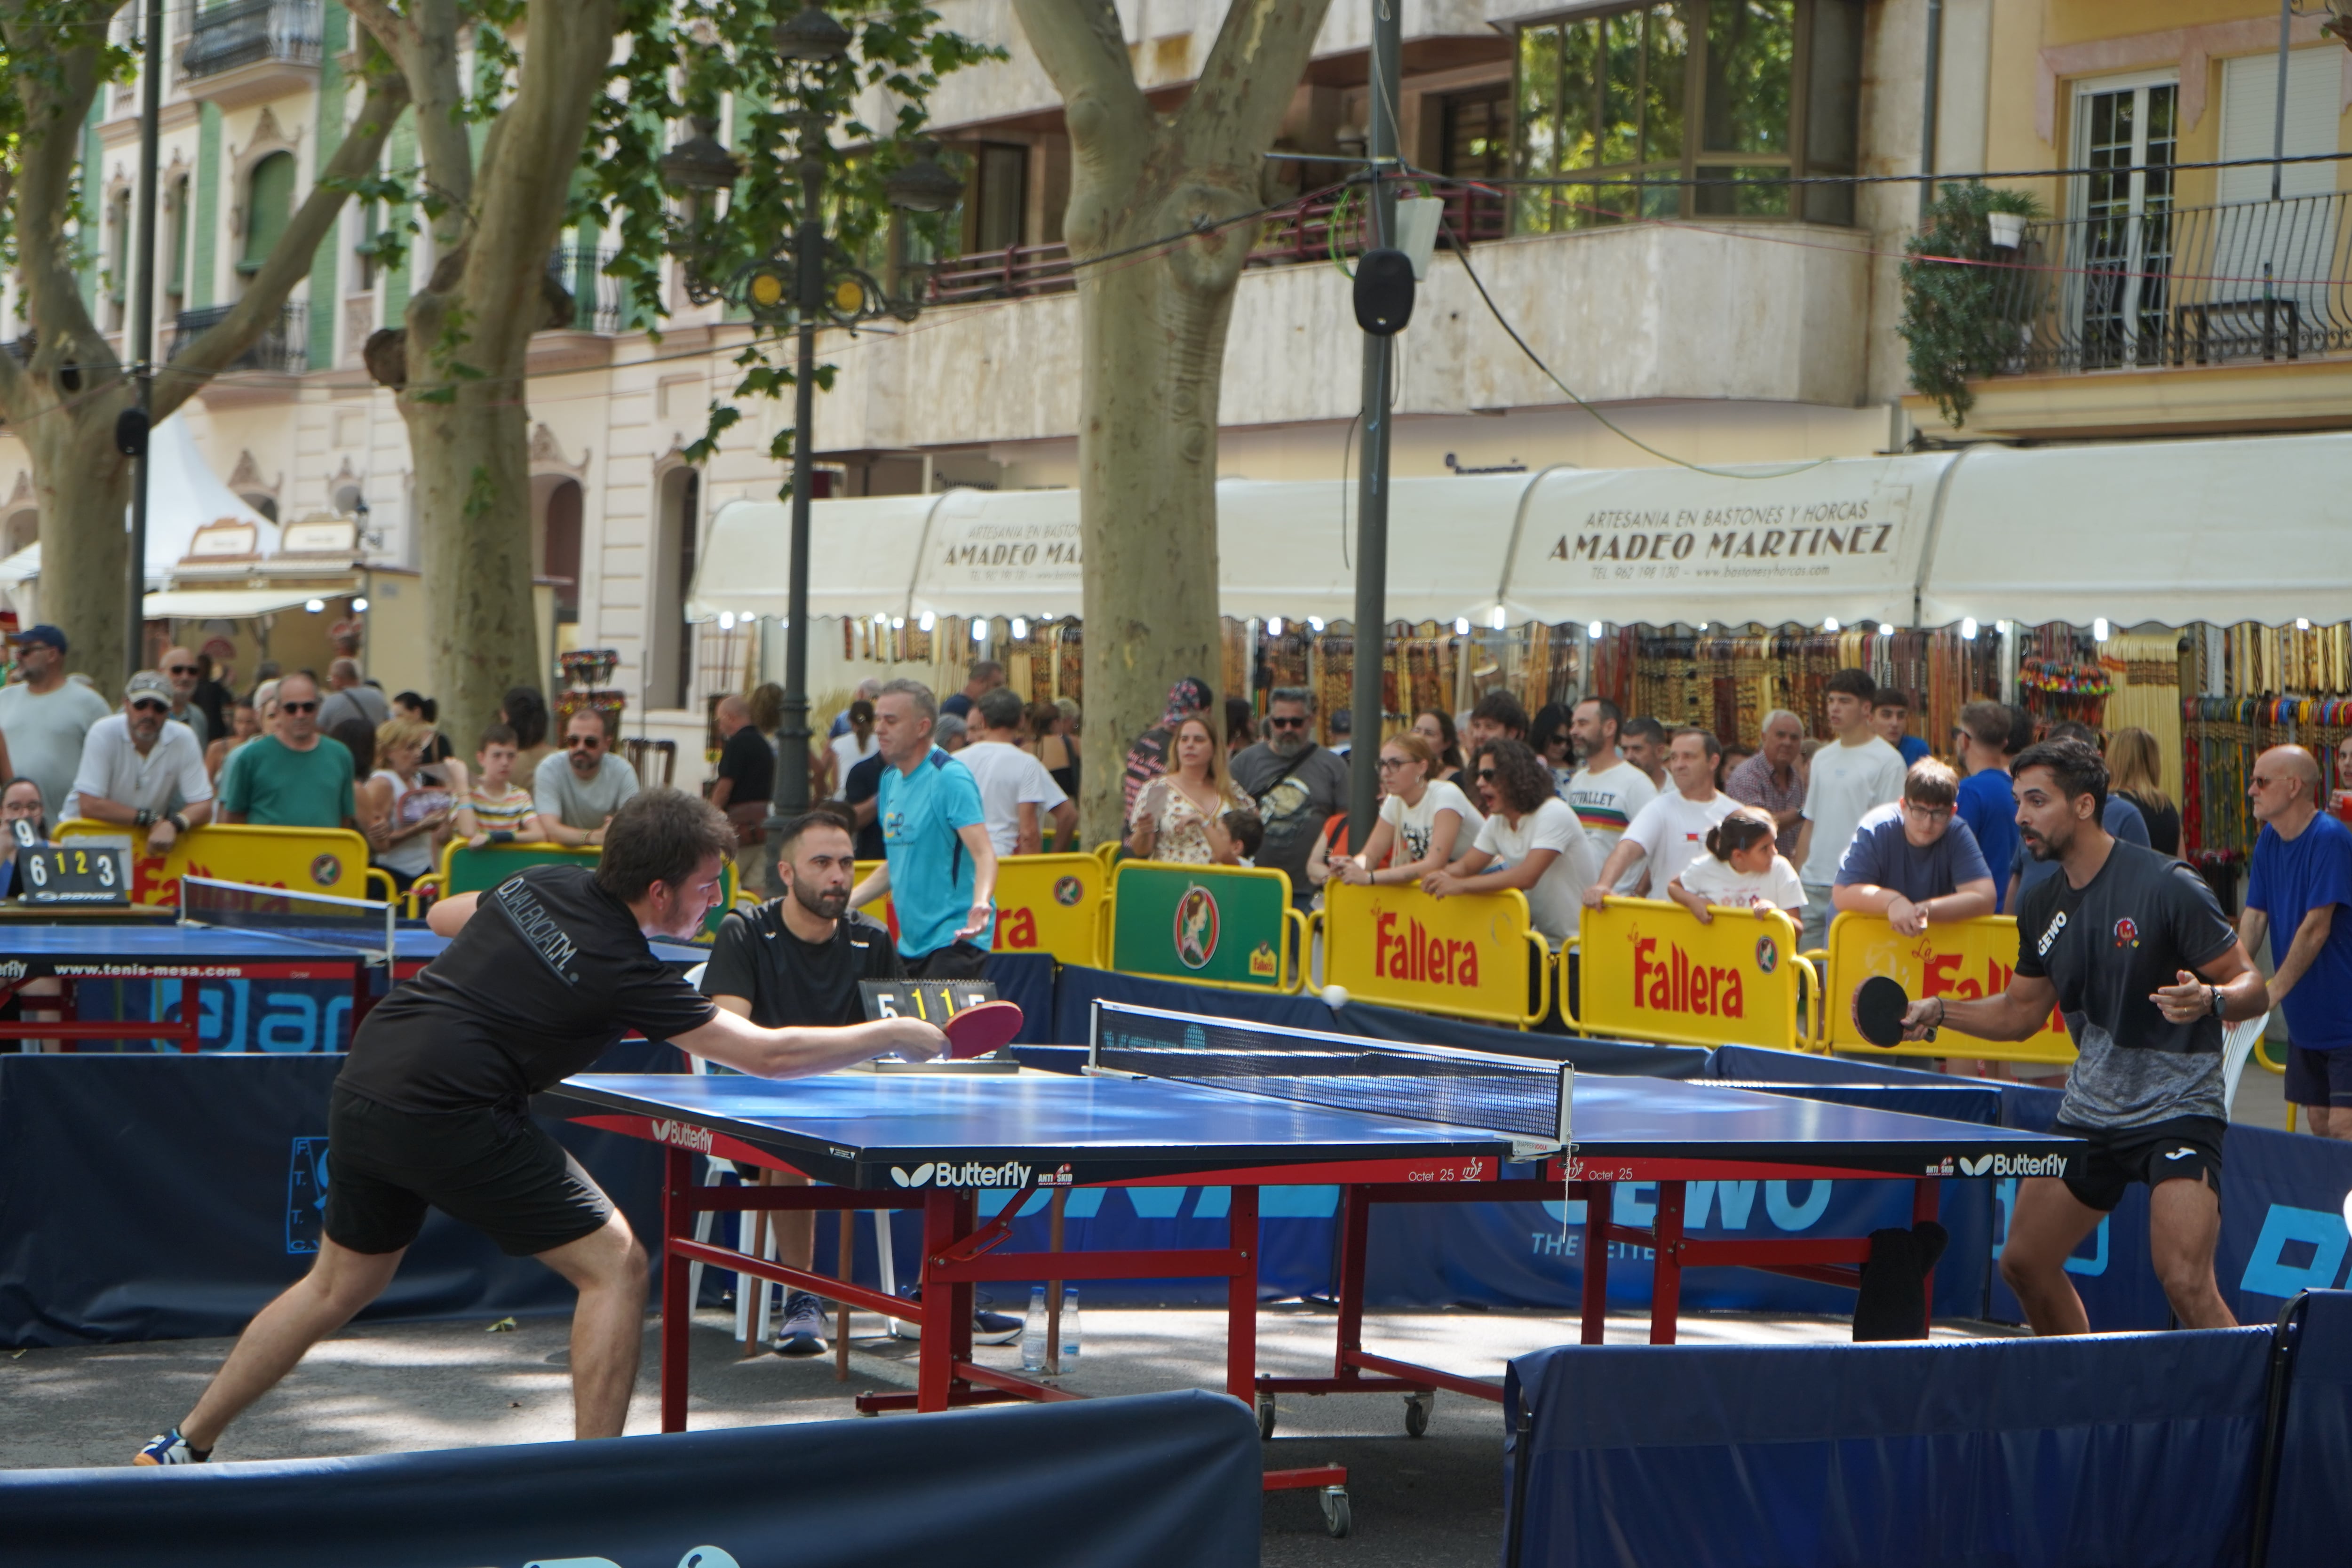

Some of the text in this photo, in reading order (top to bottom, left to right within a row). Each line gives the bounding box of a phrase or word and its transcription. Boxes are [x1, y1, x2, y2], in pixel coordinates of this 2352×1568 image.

[1585, 500, 1869, 529] ARTESANIA EN BASTONES Y HORCAS
[1026, 524, 1042, 539] EN
[1547, 523, 1893, 561] AMADEO MARTINEZ
[944, 543, 1038, 566] AMADEO
[16, 820, 34, 847] 9
[30, 855, 47, 886] 6
[55, 851, 66, 875] 1
[75, 851, 88, 874] 2
[97, 855, 115, 887] 3
[2038, 910, 2067, 956] GEWO
[1376, 912, 1478, 988] Fallera
[54, 962, 242, 977] www.tenis-mesa.com
[1634, 937, 1744, 1019] Fallera
[912, 988, 927, 1020] 1
[940, 988, 954, 1017] 1
[671, 1120, 713, 1155] Butterfly
[936, 1161, 1032, 1189] Butterfly
[1038, 1173, 1073, 1183] ANTI SKID
[1408, 1169, 1454, 1181] Octet 25
[1589, 1168, 1633, 1180] Octet 25
[1994, 1154, 2067, 1178] Butterfly
[1531, 1232, 1580, 1257] THE
